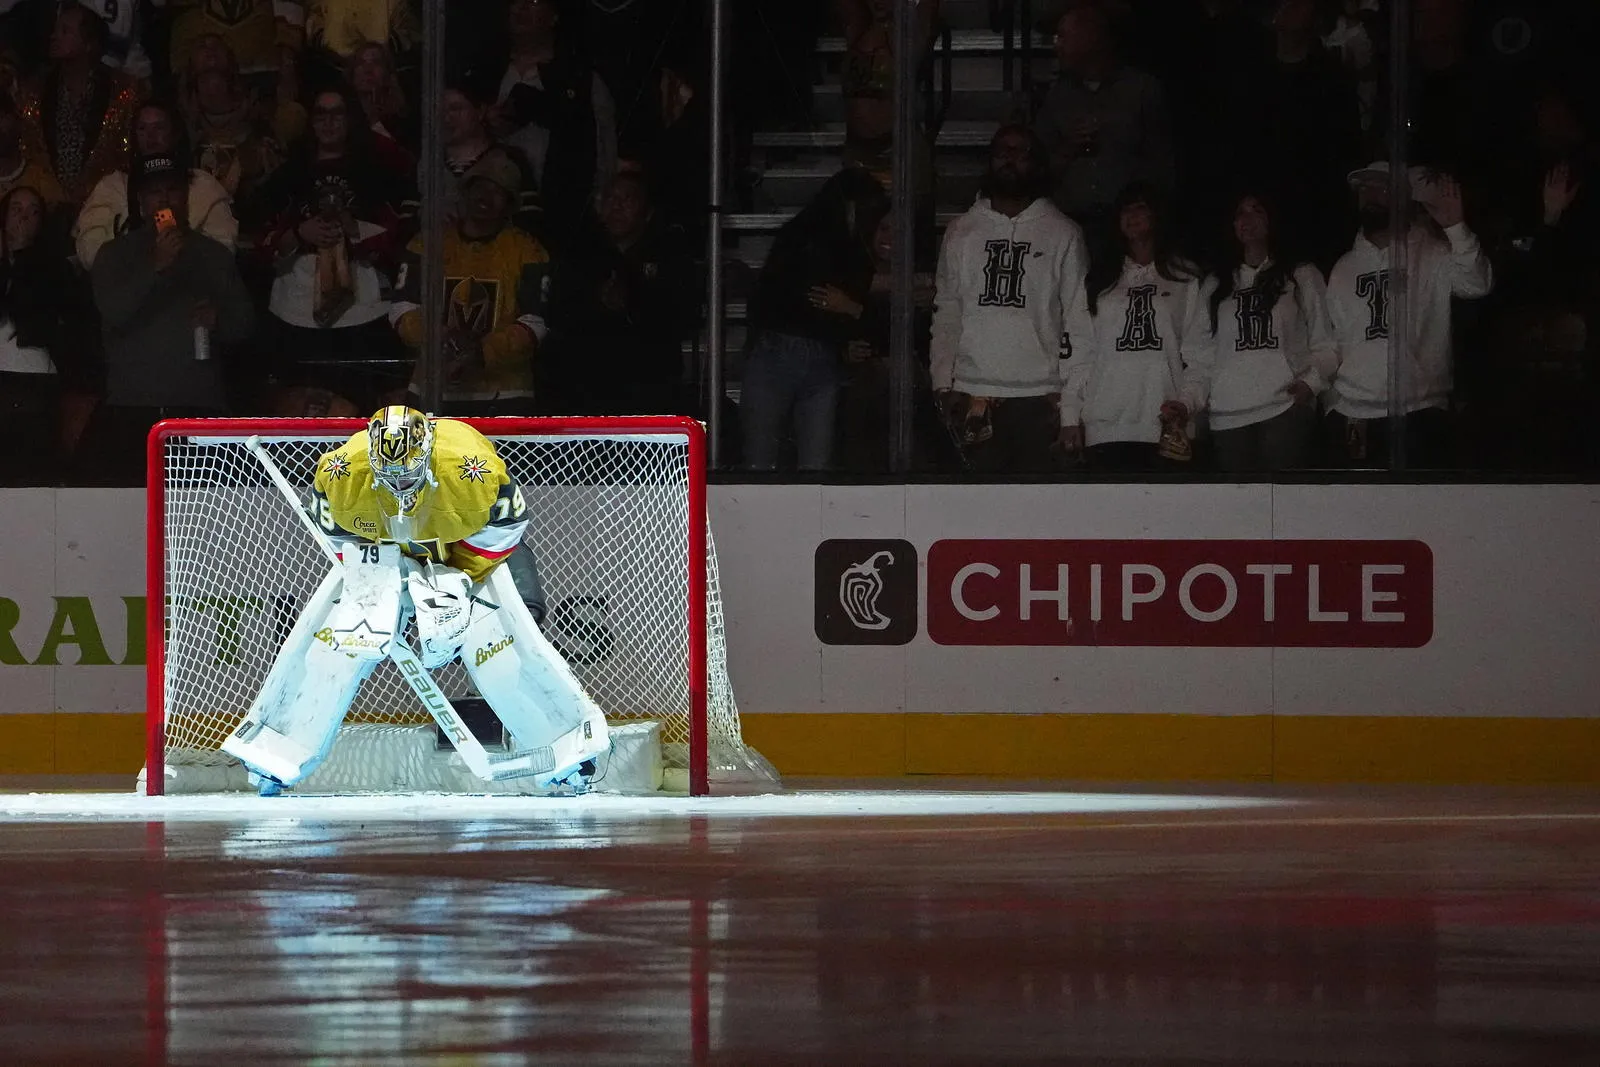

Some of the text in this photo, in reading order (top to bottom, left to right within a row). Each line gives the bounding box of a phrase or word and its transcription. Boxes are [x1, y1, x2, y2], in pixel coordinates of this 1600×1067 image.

[978, 239, 1031, 308] H
[1116, 284, 1163, 351] A
[1356, 268, 1406, 341] T
[353, 516, 377, 529] Circa
[495, 484, 526, 520] 79
[360, 545, 380, 564] 79
[950, 562, 1406, 623] CHIPOTLE
